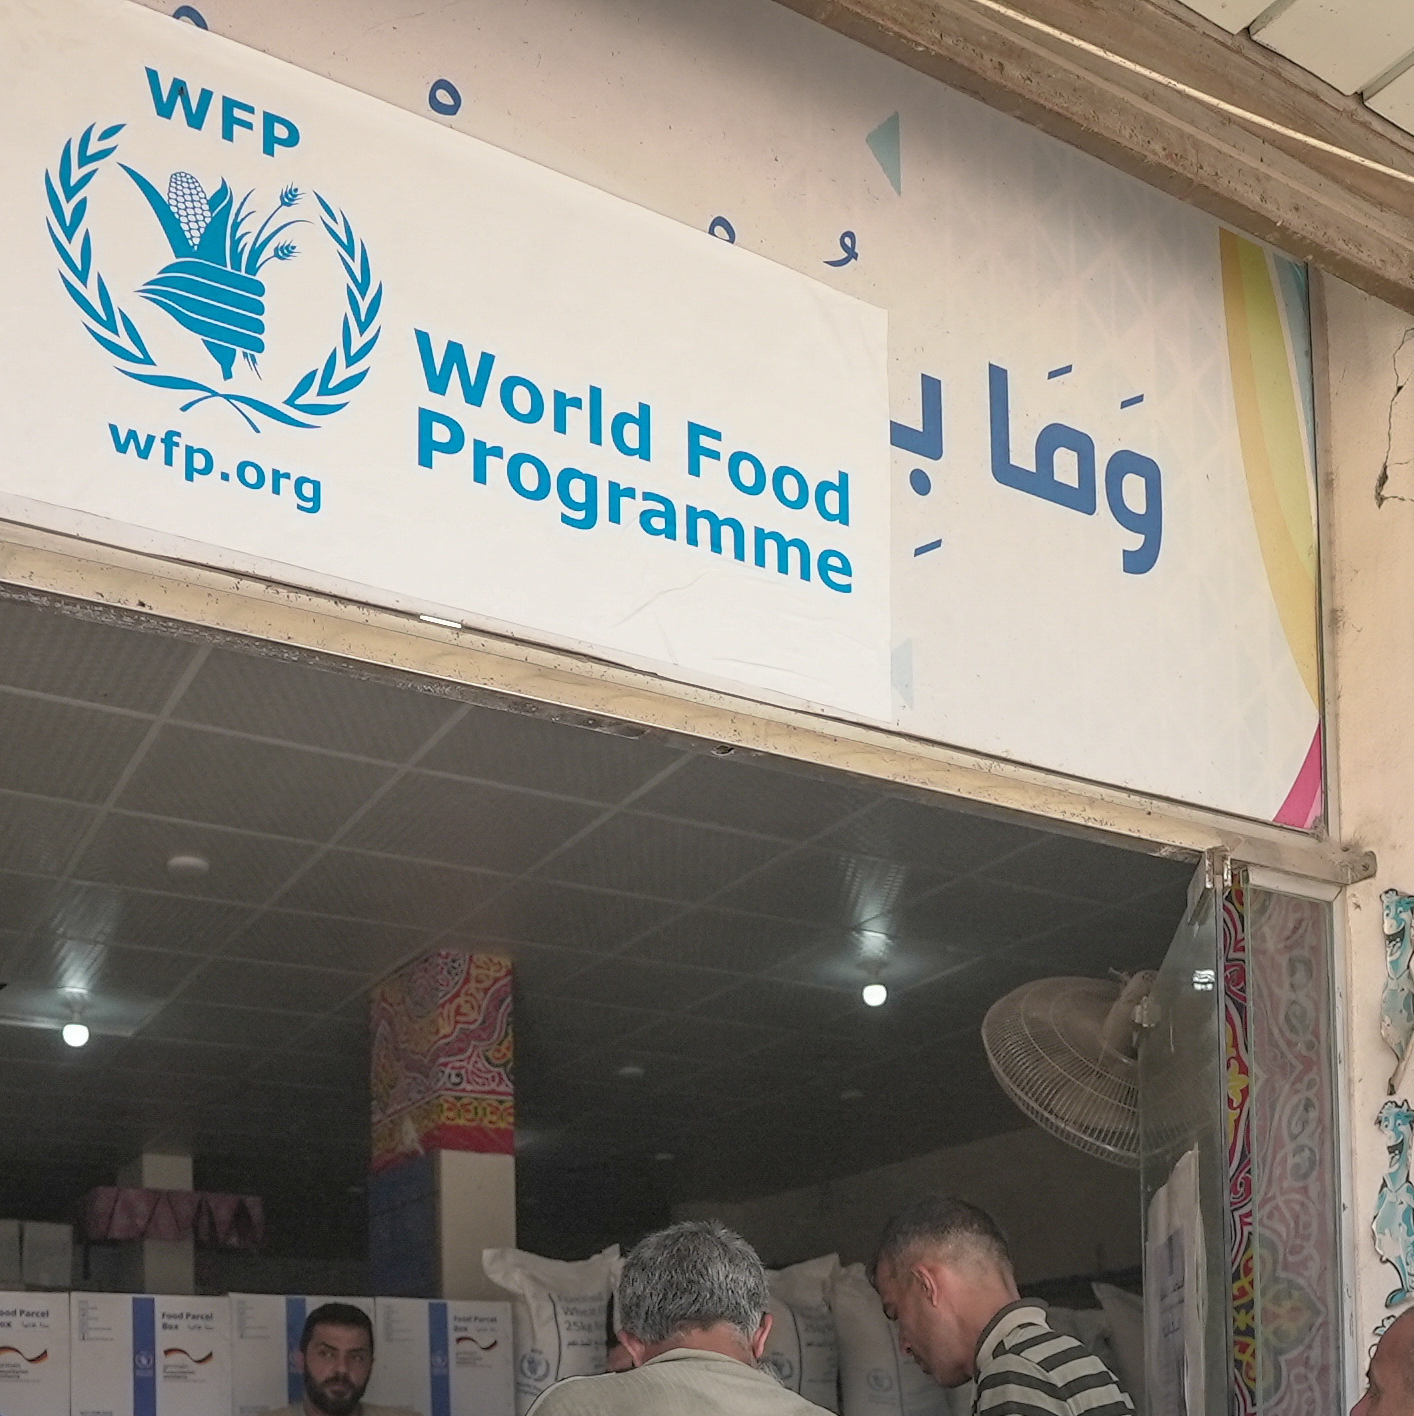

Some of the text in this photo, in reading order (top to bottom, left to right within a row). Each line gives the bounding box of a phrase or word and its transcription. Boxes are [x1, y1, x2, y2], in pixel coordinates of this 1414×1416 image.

[144, 66, 301, 158] WFP
[108, 422, 322, 515] wfp.org
[413, 328, 651, 462] World
[688, 419, 850, 527] Food
[416, 405, 853, 594] Programme
[20, 1309, 49, 1317] Parcel
